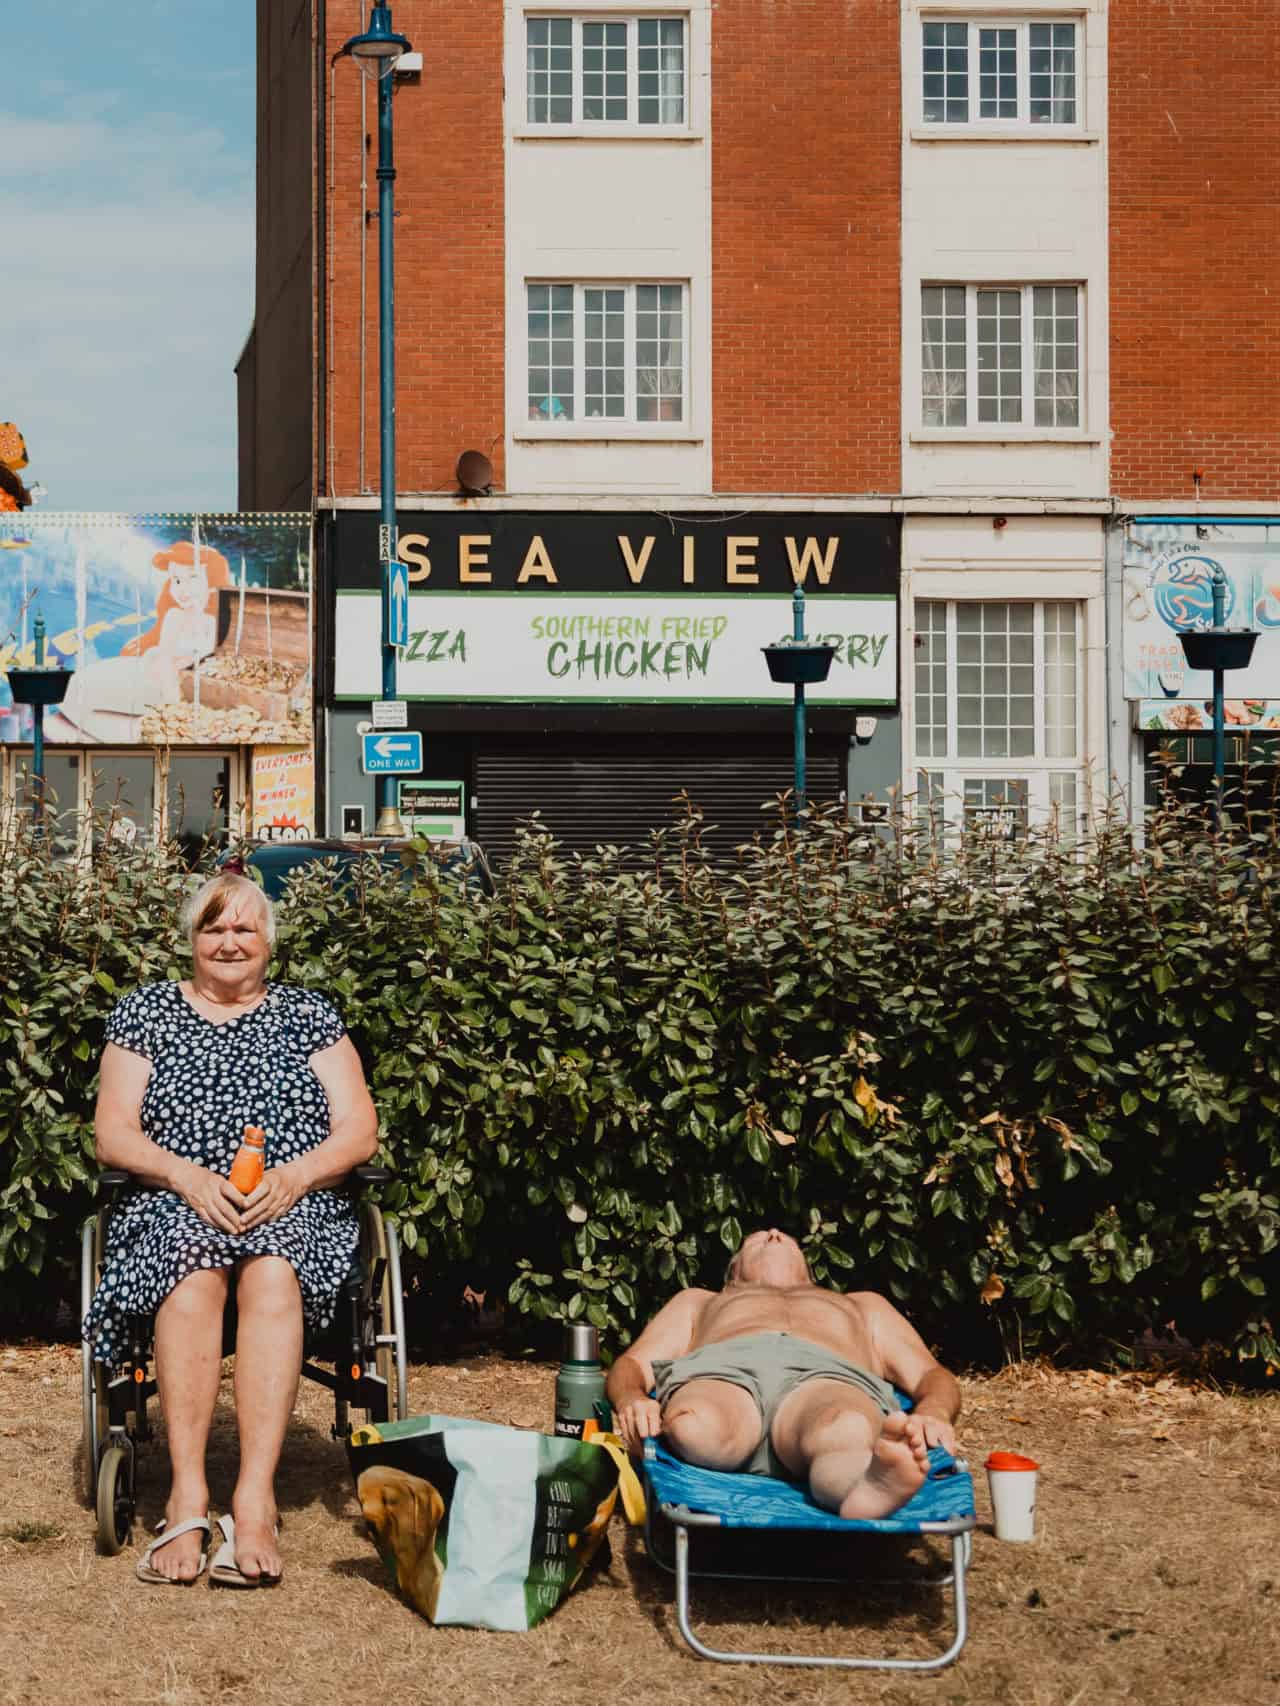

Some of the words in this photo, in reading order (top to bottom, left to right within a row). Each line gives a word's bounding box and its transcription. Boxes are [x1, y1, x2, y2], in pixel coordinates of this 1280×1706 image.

[397, 533, 558, 583] SEA
[618, 535, 840, 584] VIEW
[397, 628, 466, 665] IZZA
[530, 615, 651, 641] SOUTHERN
[660, 615, 729, 640] FRIED
[547, 639, 713, 682] CHICKEN
[368, 759, 391, 769] ONE
[394, 759, 417, 768] WAY
